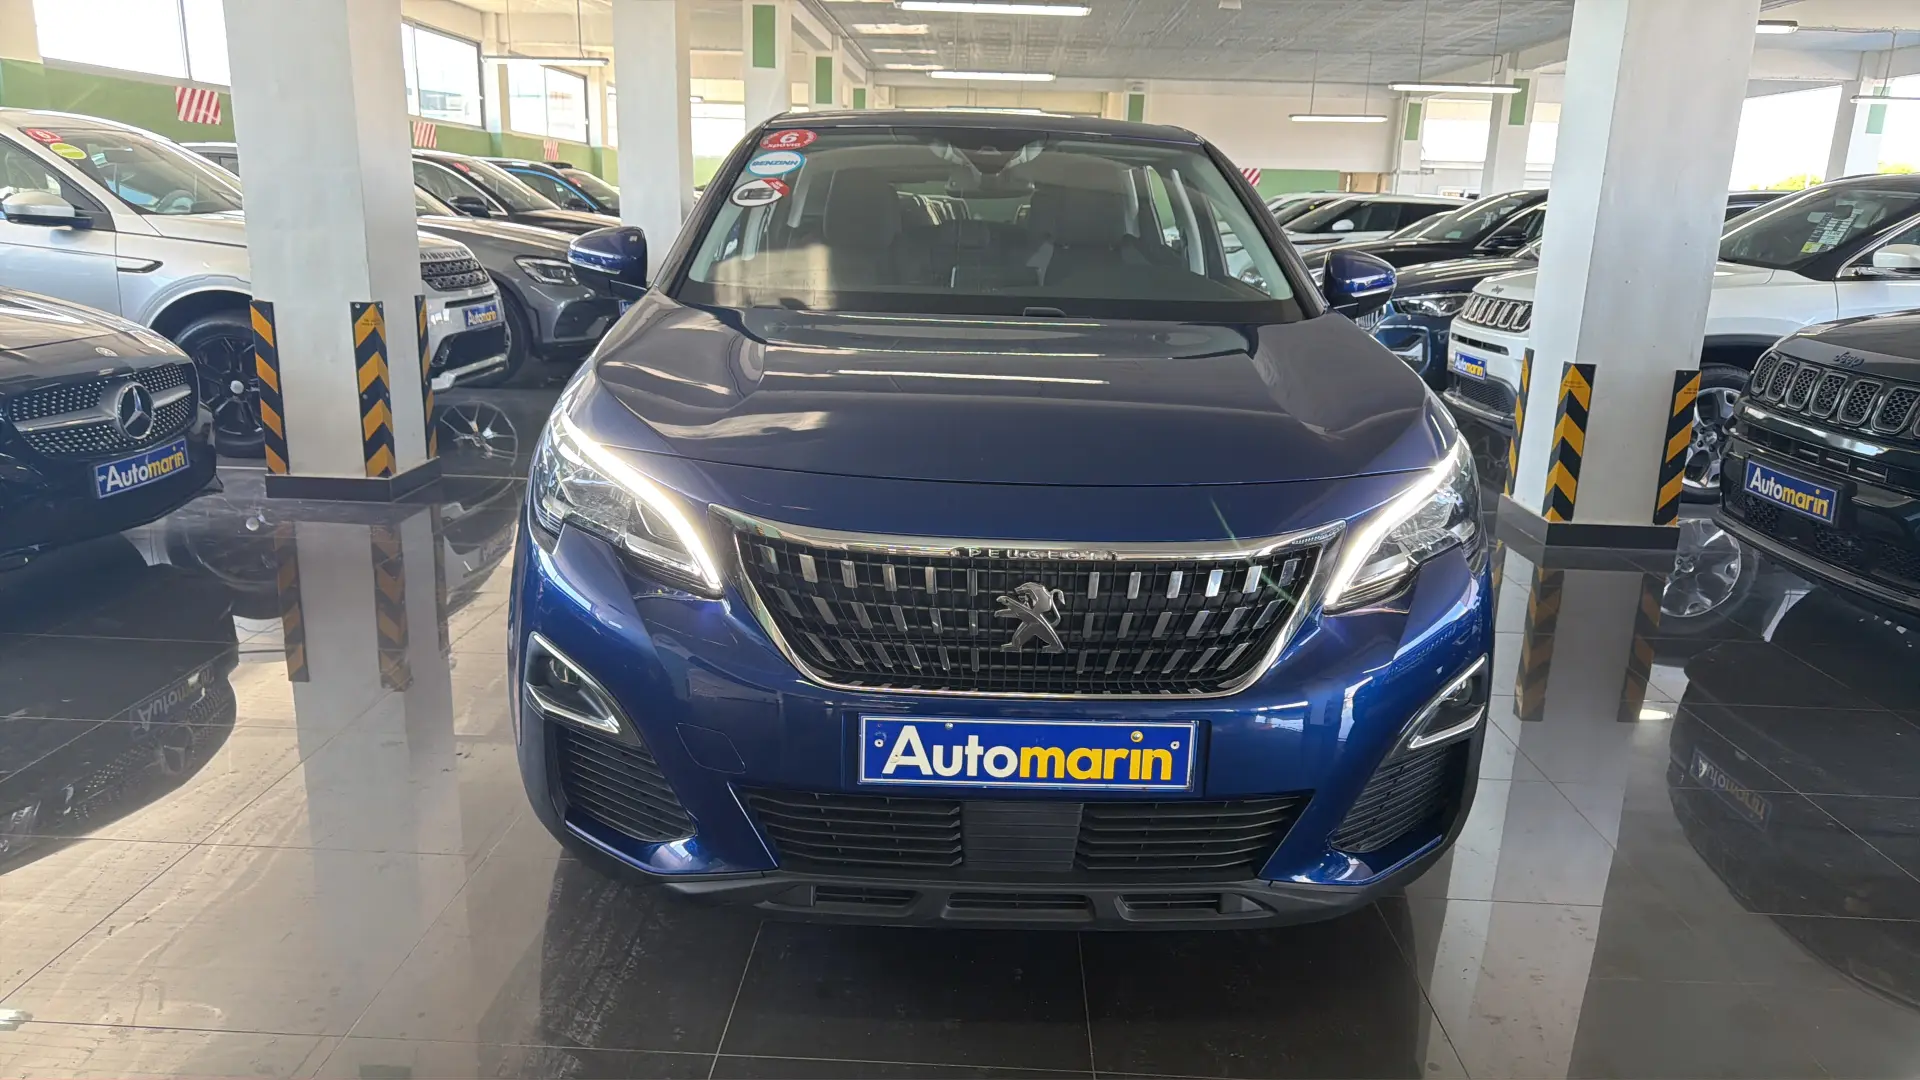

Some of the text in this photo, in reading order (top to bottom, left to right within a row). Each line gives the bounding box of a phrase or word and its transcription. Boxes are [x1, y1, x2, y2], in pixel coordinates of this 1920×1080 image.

[780, 132, 800, 144] 6
[106, 446, 185, 492] Automarin
[1750, 467, 1829, 517] Automarin
[968, 548, 1097, 560] PEUGEOT
[882, 725, 1173, 781] Automarin
